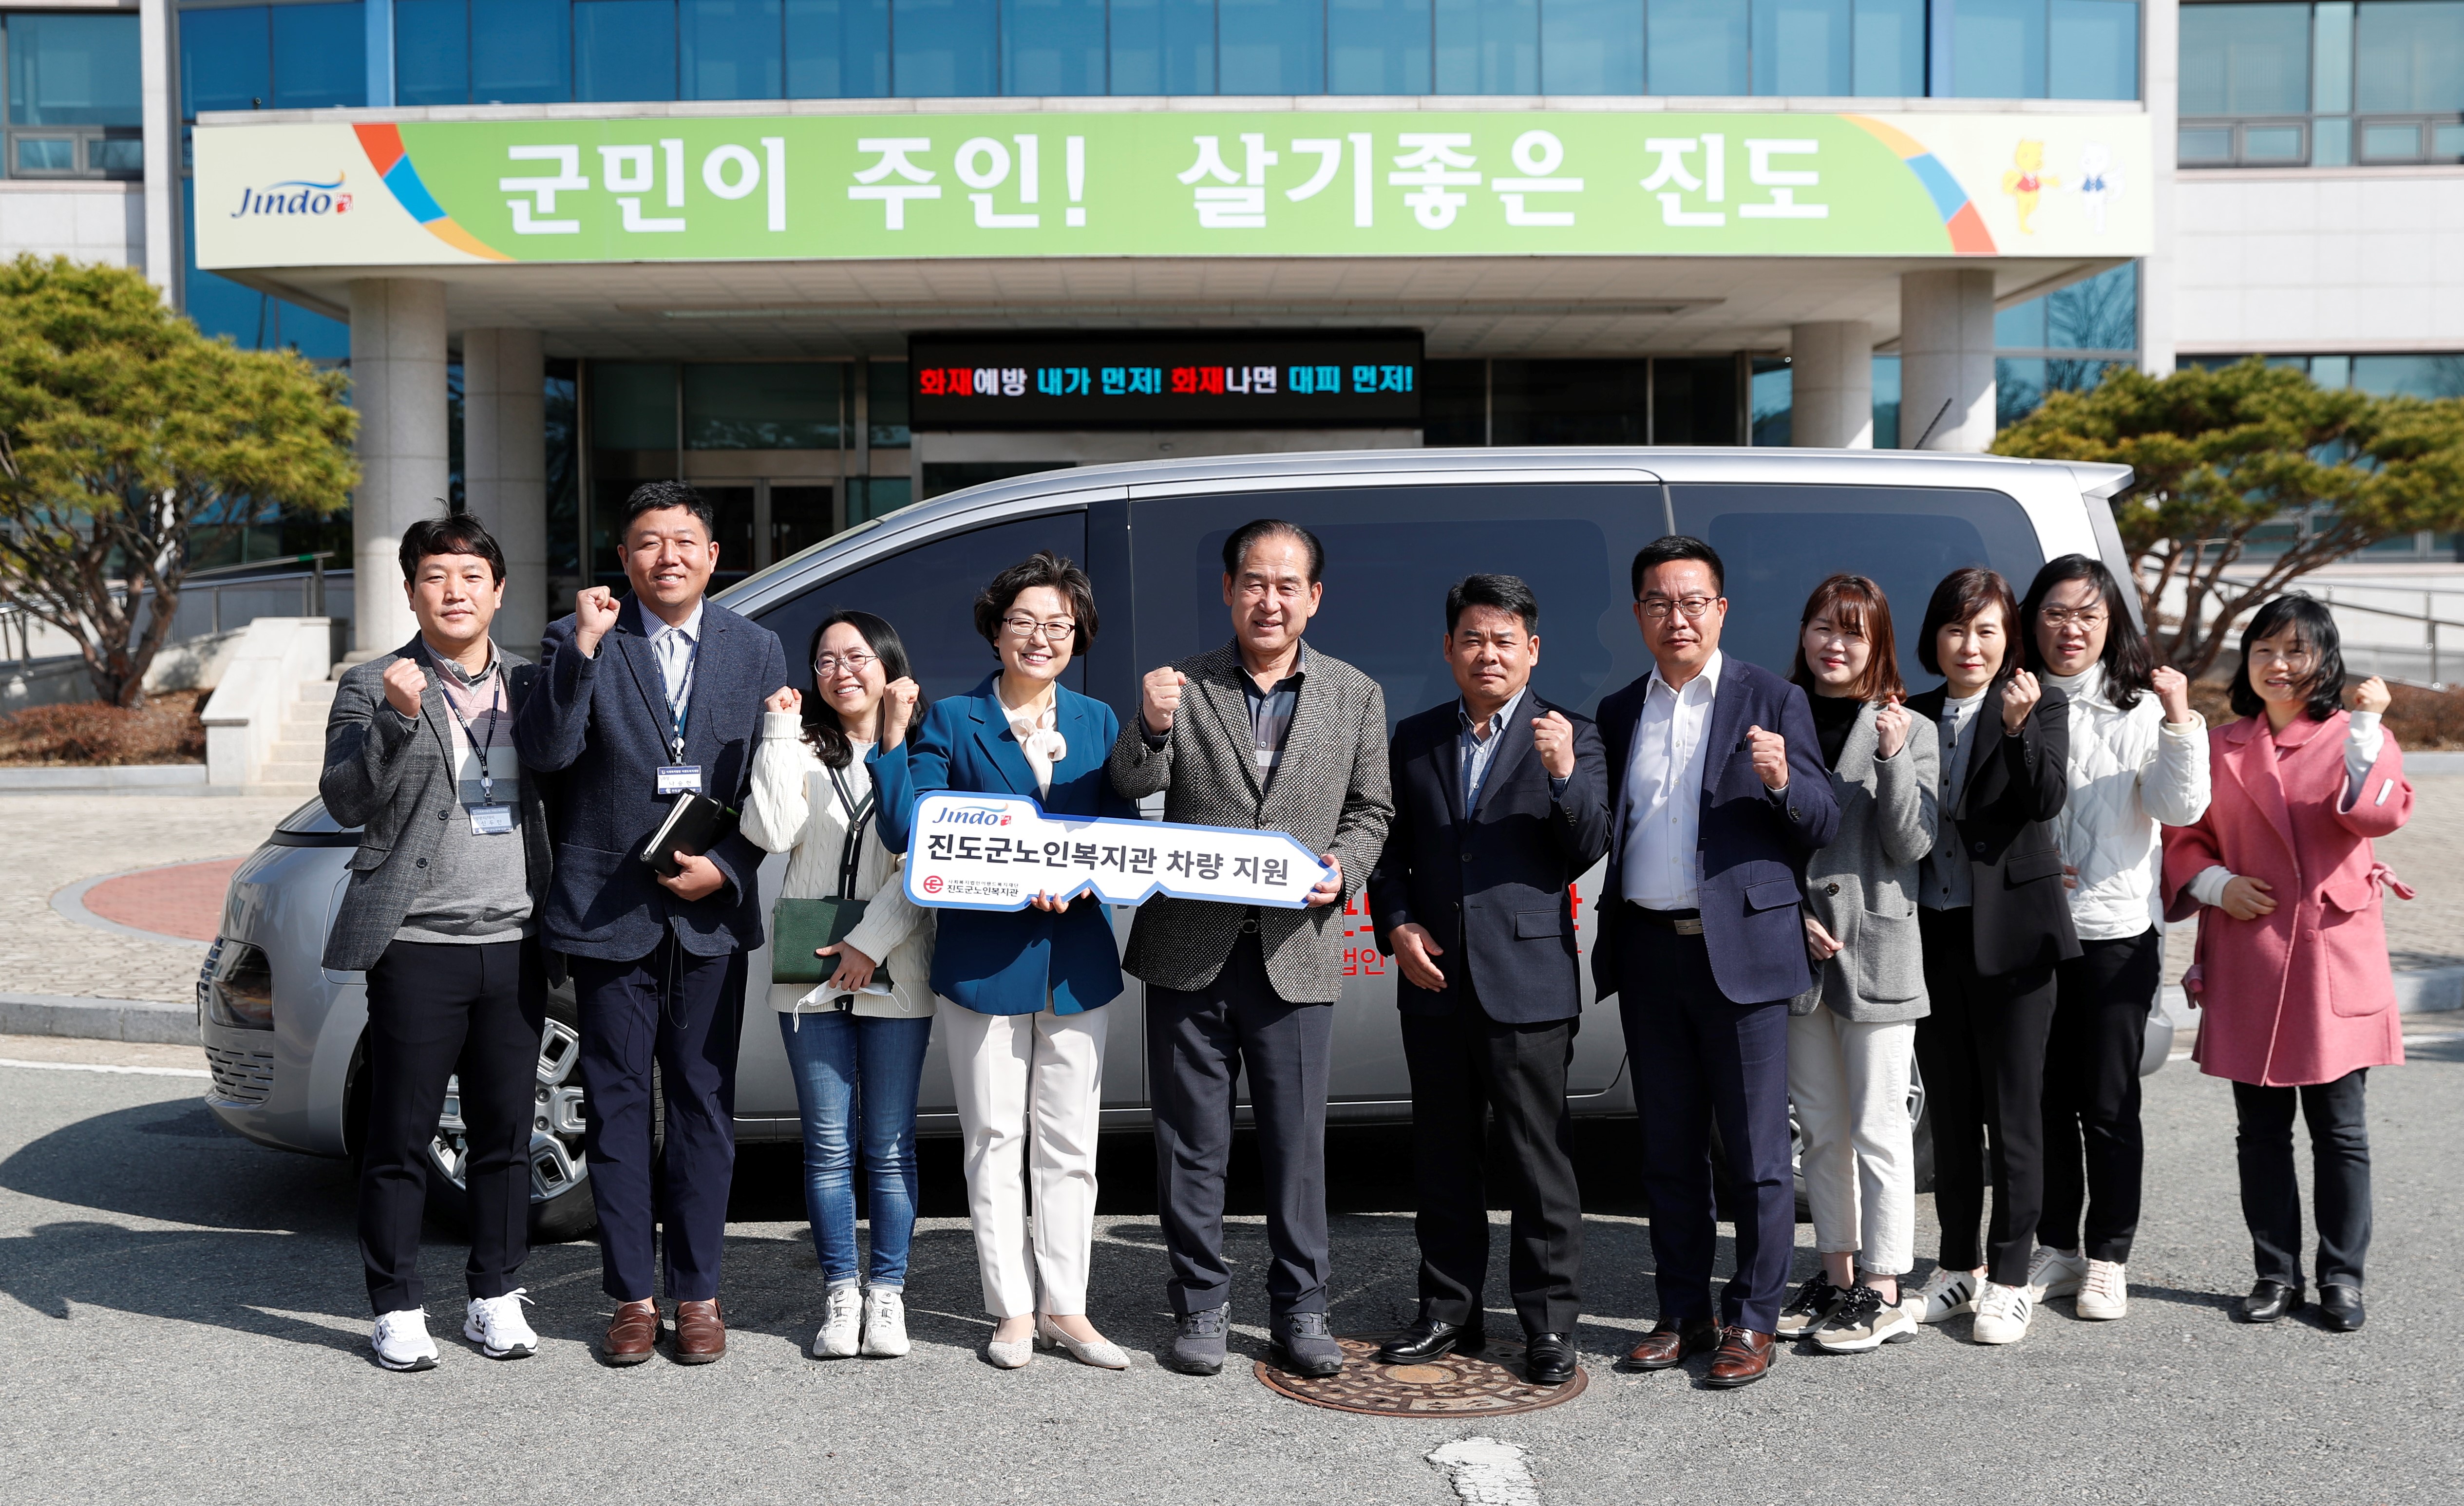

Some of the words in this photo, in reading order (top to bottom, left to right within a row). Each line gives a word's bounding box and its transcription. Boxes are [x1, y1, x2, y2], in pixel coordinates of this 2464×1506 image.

[498, 137, 786, 234] 군민이
[848, 134, 1086, 230] 주인!
[1176, 130, 1585, 230] 살기좋은
[1639, 133, 1830, 227] 진도
[231, 188, 331, 218] Jindo
[1038, 368, 1091, 395] 내가
[1101, 368, 1161, 394] 먼저!
[1289, 366, 1340, 394] 대피
[1353, 366, 1412, 393] 먼저!
[932, 808, 998, 825] Jindo
[928, 833, 1157, 875] 진도군노인복지관
[1167, 849, 1224, 880] 차량
[1233, 855, 1288, 886] 지원
[947, 885, 1019, 897] 진도군노인복지관
